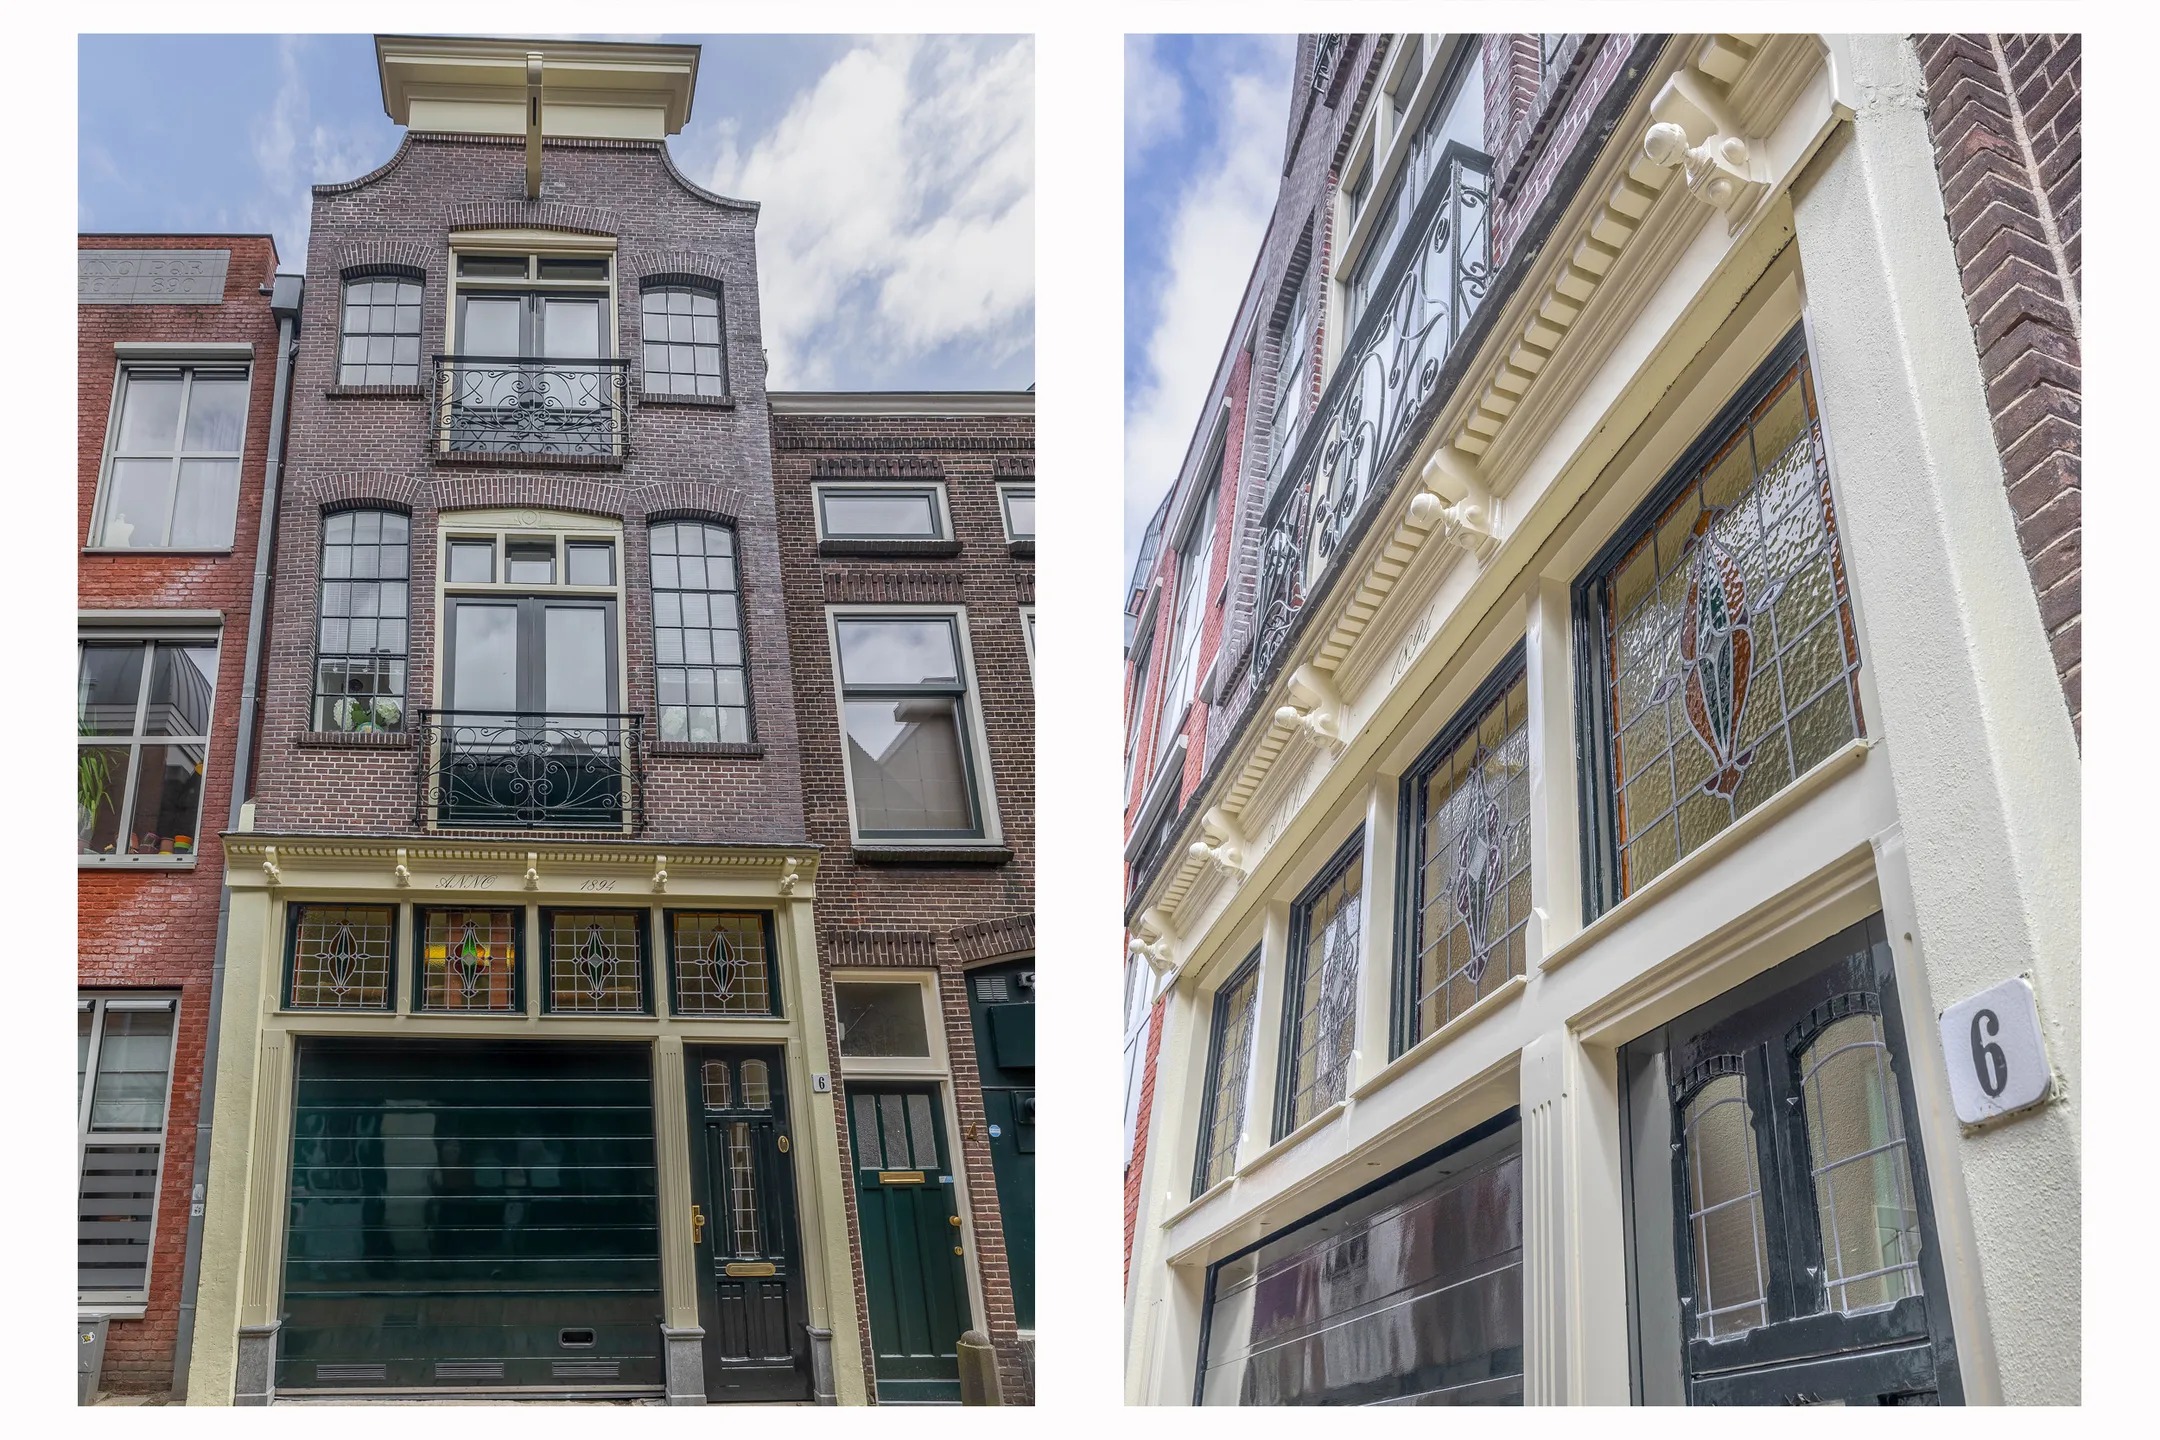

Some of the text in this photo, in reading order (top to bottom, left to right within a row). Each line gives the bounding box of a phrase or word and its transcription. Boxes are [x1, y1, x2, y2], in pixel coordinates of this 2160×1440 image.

[148, 260, 203, 275] PQR
[1389, 603, 1436, 686] 1894
[435, 873, 617, 892] ANNO 1894
[1970, 1008, 2009, 1098] 6
[818, 1076, 825, 1090] 6
